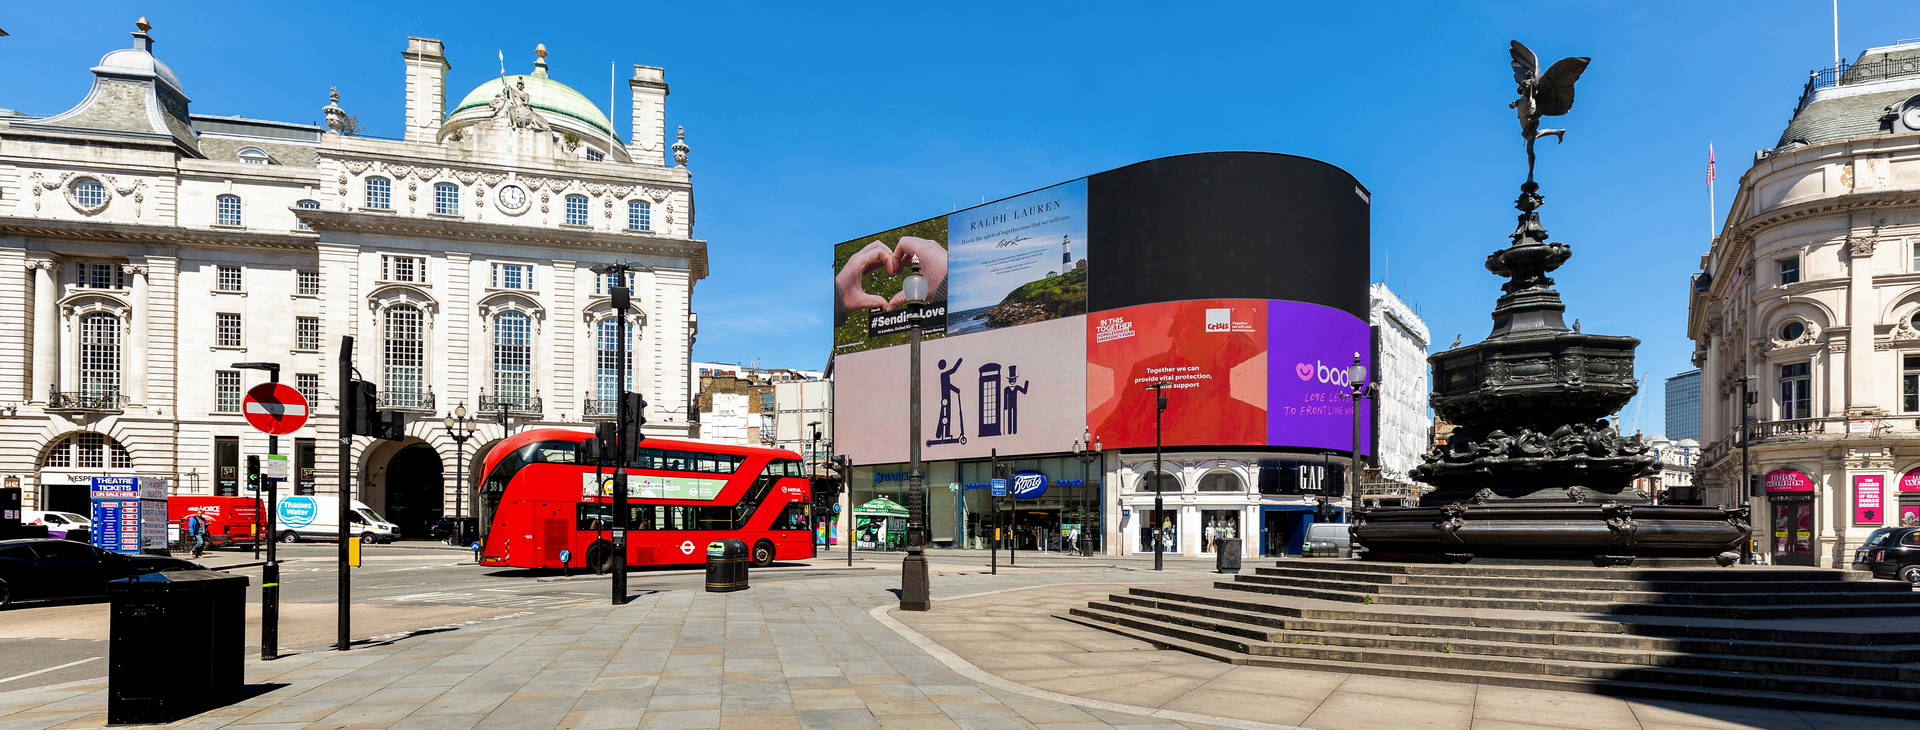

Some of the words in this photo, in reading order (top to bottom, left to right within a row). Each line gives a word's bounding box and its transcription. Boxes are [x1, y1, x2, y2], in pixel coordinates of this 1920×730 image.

[971, 213, 1007, 231] RALPH
[1014, 200, 1061, 220] LAUREN
[871, 311, 912, 329] #Sendin
[920, 306, 945, 319] Love
[1108, 316, 1124, 325] THIS
[1096, 321, 1133, 333] TOGETHER
[1146, 367, 1176, 375] Together
[1317, 360, 1359, 389] bad
[1134, 375, 1159, 384] provide
[1175, 373, 1213, 382] protection,
[1172, 382, 1200, 390] support
[1305, 393, 1326, 403] LOVE
[1283, 407, 1297, 416] TO
[96, 477, 134, 485] THEATRE
[882, 471, 925, 481] BARCLS
[1300, 465, 1324, 490] GAP
[489, 481, 498, 492] 38
[1014, 475, 1042, 494] Boots
[283, 501, 312, 510] Thames
